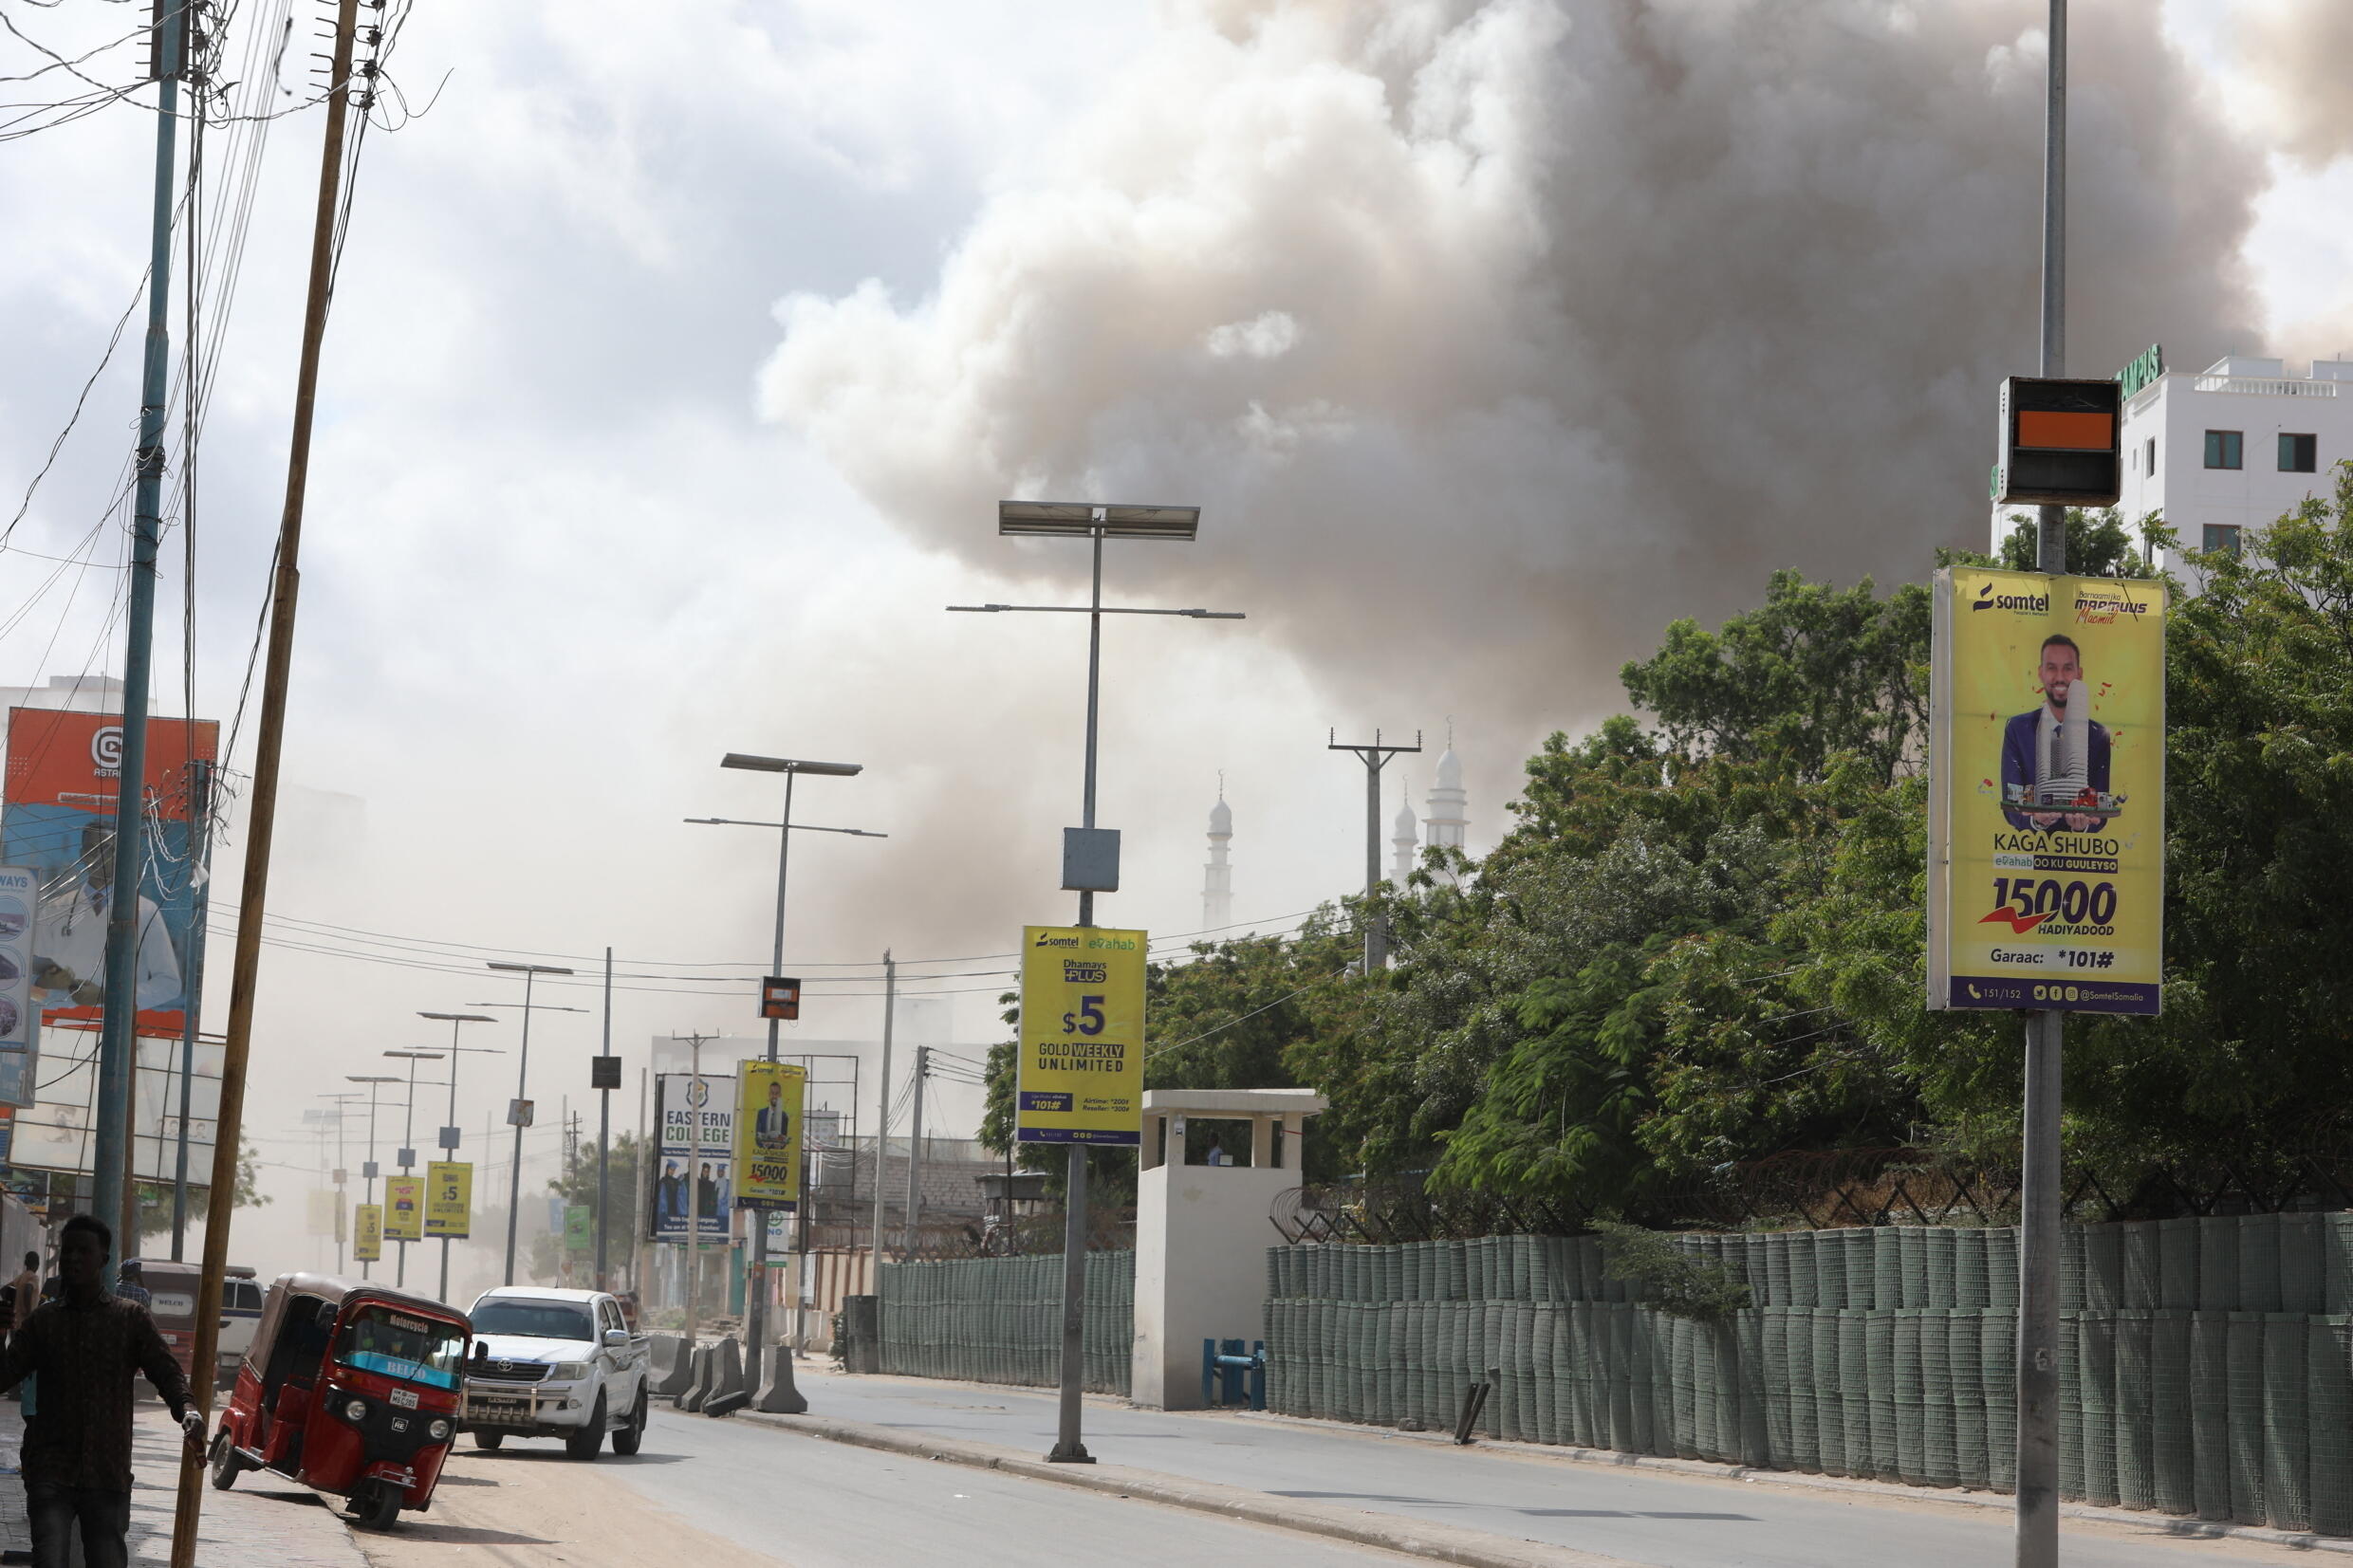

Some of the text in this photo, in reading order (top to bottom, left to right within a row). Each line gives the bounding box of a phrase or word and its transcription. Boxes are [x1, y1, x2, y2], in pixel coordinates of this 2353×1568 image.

[2116, 342, 2161, 402] AMPUS
[1996, 593, 2049, 612] somtel
[1994, 833, 2120, 856] KAGA SHUBO
[2050, 858, 2065, 869] KU
[2066, 859, 2118, 871] GUULEYSO
[1993, 877, 2117, 926] 15000
[2038, 925, 2115, 936] HADIYADOOD
[1049, 937, 1079, 948] somtel
[1064, 959, 1107, 969] Dhamays
[1991, 948, 2045, 965] Garaac:
[1983, 987, 2022, 999] 151/152
[1063, 995, 1105, 1036] $5
[1039, 1042, 1122, 1058] GOLD WEEKLY
[1039, 1058, 1123, 1073] UNLIMITED
[667, 1110, 731, 1127] EASERN
[666, 1126, 730, 1143] COLEGE
[751, 1163, 787, 1181] 15000
[390, 1314, 429, 1334] Motorcycle
